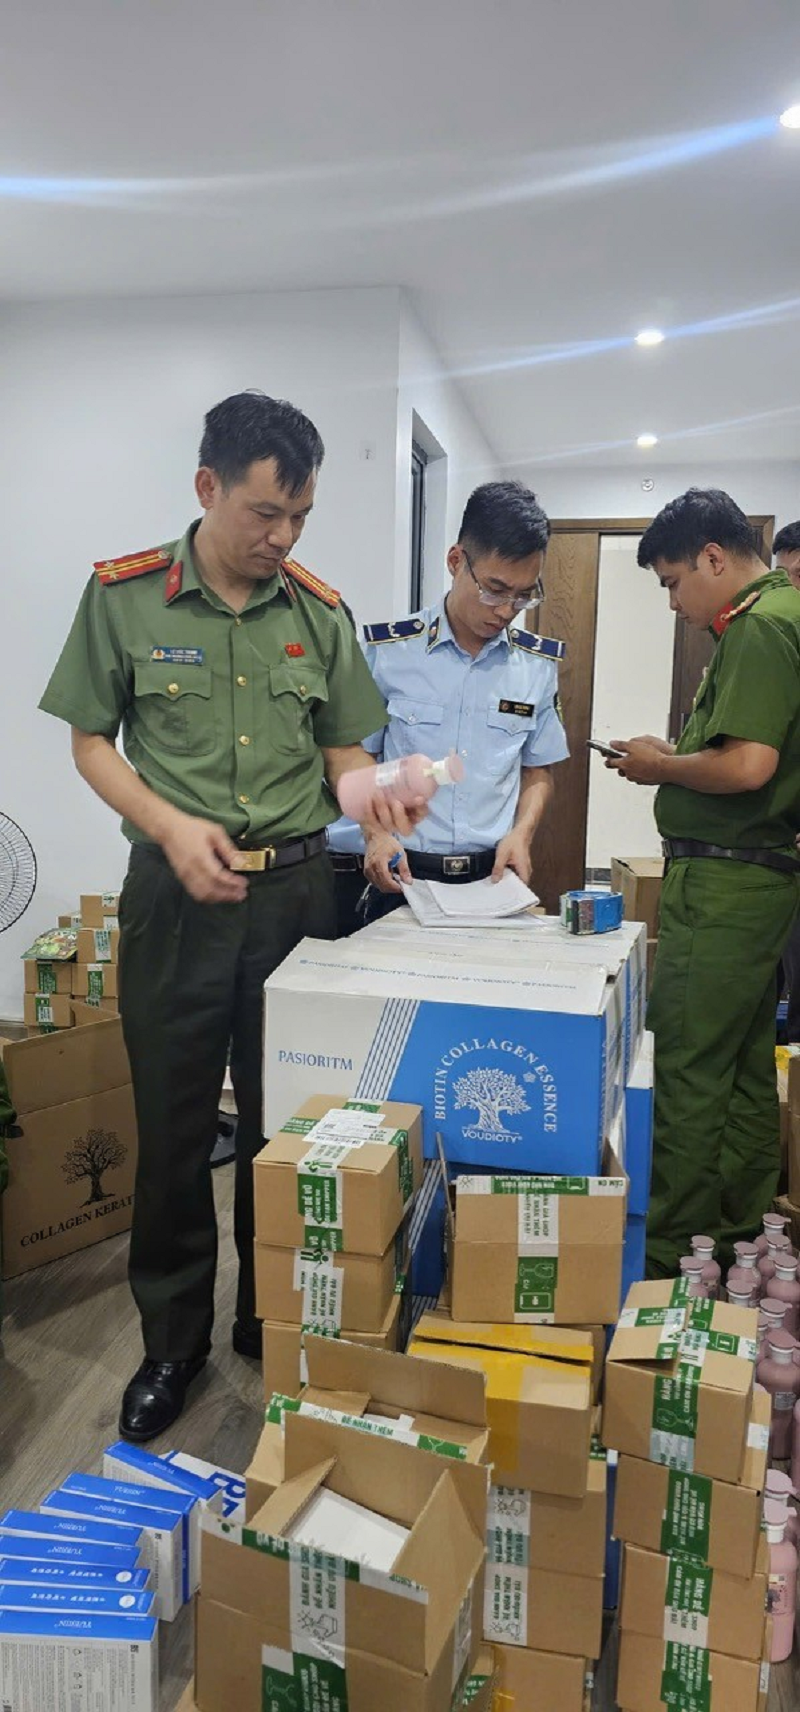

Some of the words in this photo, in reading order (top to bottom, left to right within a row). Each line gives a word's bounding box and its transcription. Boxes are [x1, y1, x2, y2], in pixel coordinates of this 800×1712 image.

[278, 1050, 353, 1071] PASIORITM
[441, 1038, 539, 1067] COLLAGEN
[435, 1067, 448, 1120] BIOTIN
[534, 1064, 557, 1132] ESSENCE
[20, 1211, 93, 1247] COLLAGEN
